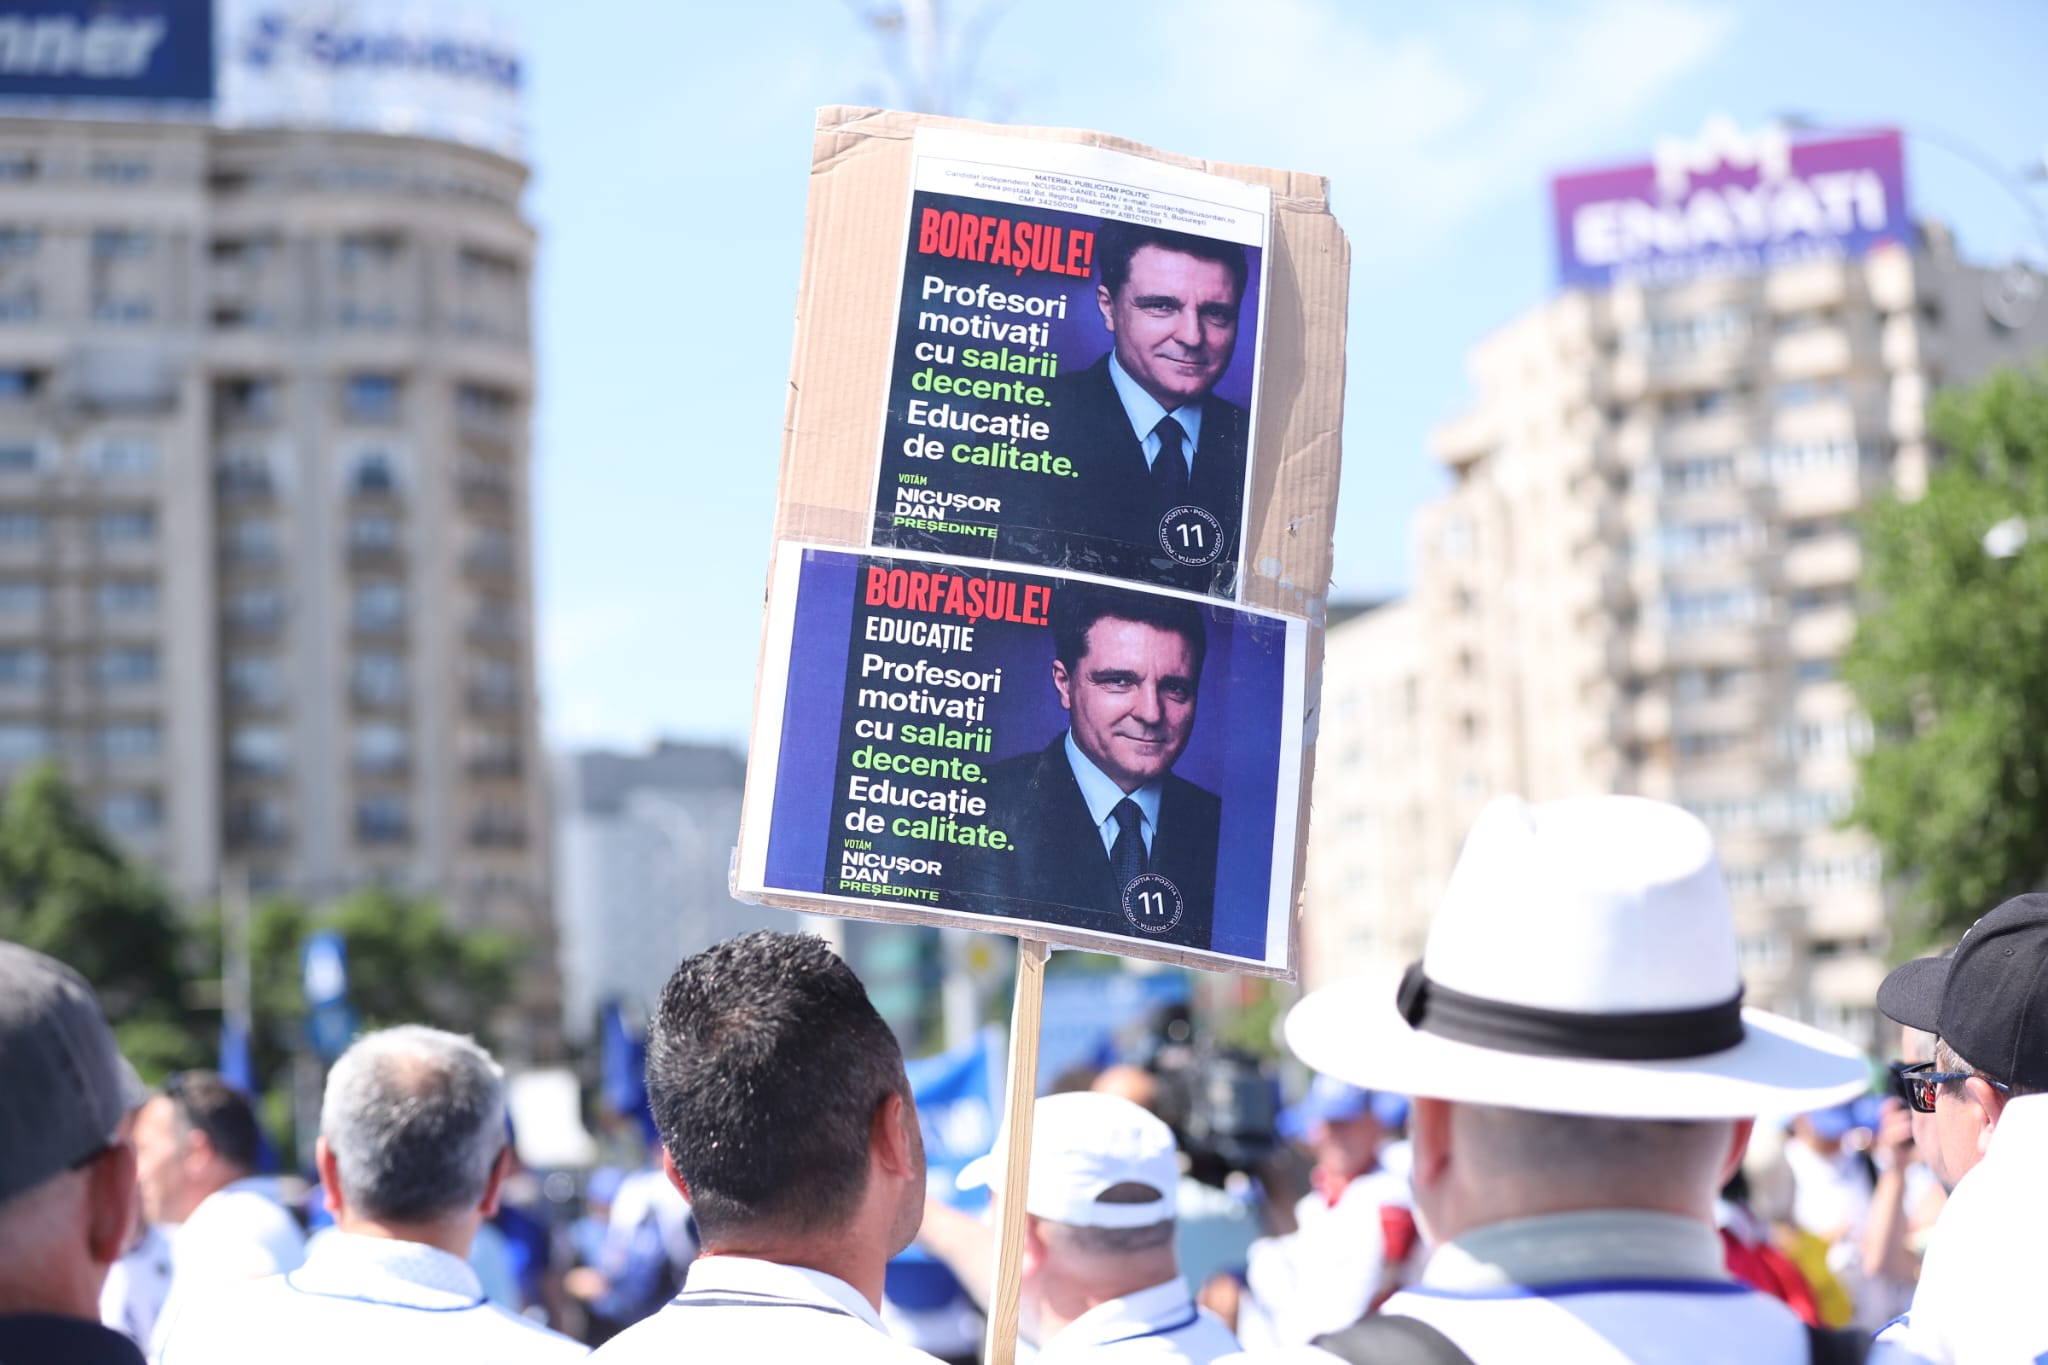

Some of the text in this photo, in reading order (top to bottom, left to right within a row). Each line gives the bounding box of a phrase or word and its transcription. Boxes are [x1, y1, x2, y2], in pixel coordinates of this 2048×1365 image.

[945, 170, 980, 179] Candidat
[982, 174, 1029, 187] independent
[1035, 174, 1150, 199] MATERIAL PUBLICITAR POLITIC
[975, 181, 1001, 191] Adresa
[1048, 192, 1074, 202] Regina
[1076, 196, 1110, 207] Elisabeta
[1136, 207, 1161, 217] Sector
[1572, 168, 1888, 265] ENAYATI
[918, 207, 1095, 278] BORFAȘULE!
[922, 275, 1067, 319] Profesori
[918, 311, 1049, 352] motivați
[915, 341, 1058, 378] cu salarii
[911, 368, 1052, 407] decente.
[907, 399, 1050, 444] Educație
[903, 433, 1079, 478] de calitate.
[895, 502, 944, 521] DAN
[897, 487, 1001, 513] NICUȘOR
[893, 517, 998, 538] PREȘEDINTE
[1176, 523, 1203, 548] 11
[865, 566, 1052, 626] BORFAȘULE!
[865, 616, 974, 653] EDUCAȚIE
[862, 653, 1002, 693] Profesori
[858, 688, 985, 727] motivați
[855, 719, 992, 753] cu salarii
[852, 745, 988, 784] decente.
[848, 775, 986, 819] Educație
[845, 807, 1015, 851] de calitate.
[841, 865, 888, 884] DAN
[842, 851, 943, 876] NICUȘOR
[839, 880, 940, 901] PREȘEDINTE
[1138, 891, 1164, 915] 11
